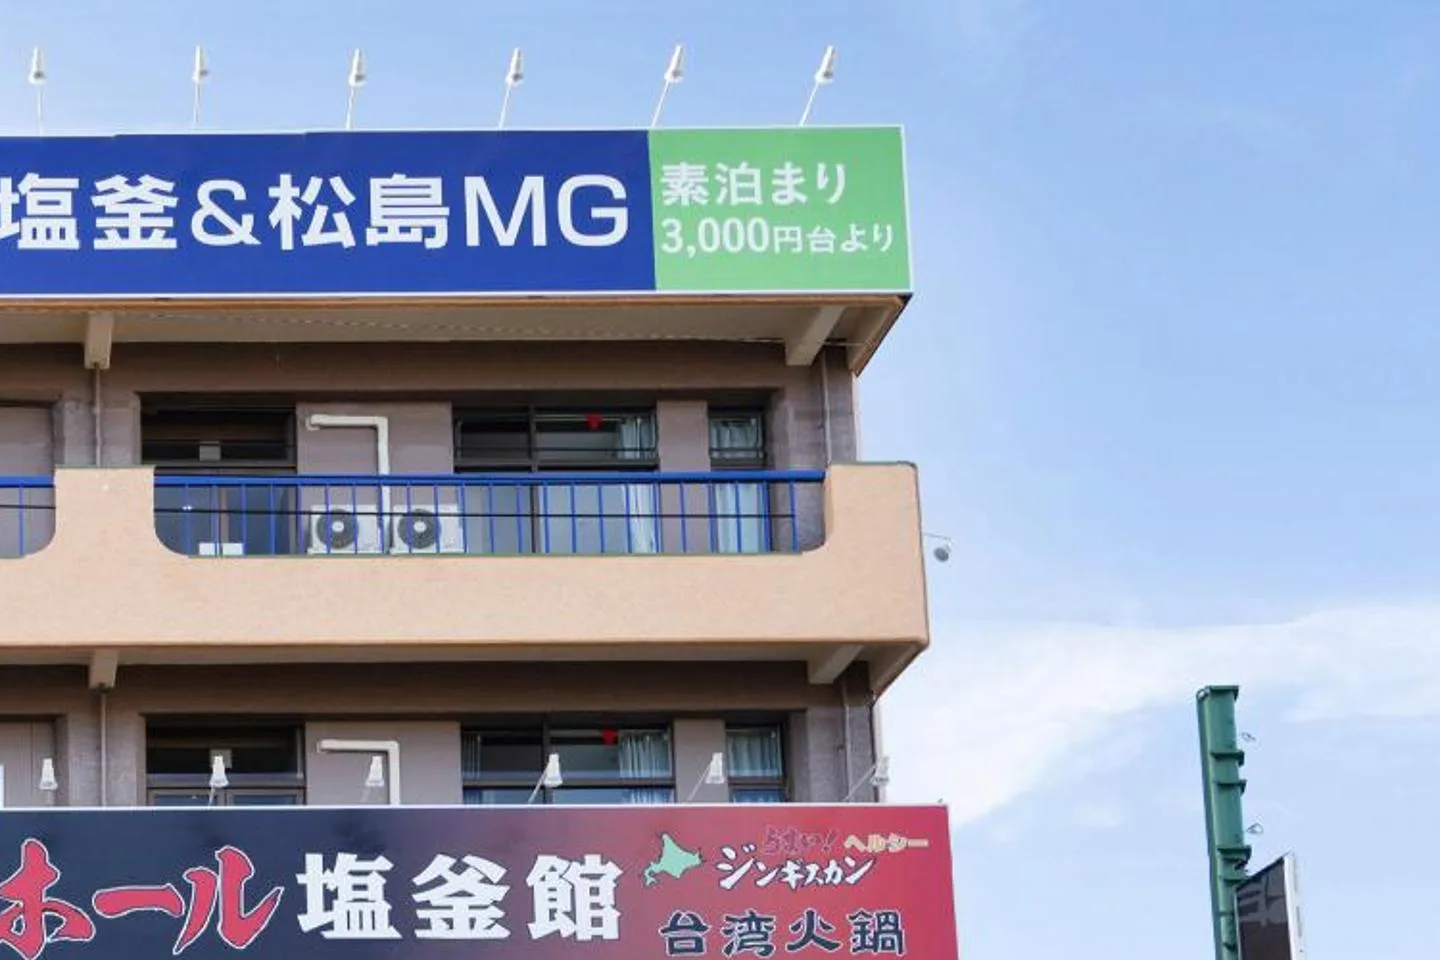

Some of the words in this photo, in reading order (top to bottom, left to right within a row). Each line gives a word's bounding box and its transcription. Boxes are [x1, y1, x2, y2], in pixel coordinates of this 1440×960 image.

[661, 161, 848, 206] 素泊まり
[661, 218, 894, 255] 3,000円台より
[716, 842, 875, 891] ジンギスカン
[295, 851, 623, 941] 塩釜館
[659, 907, 908, 959] 台湾火鍋
